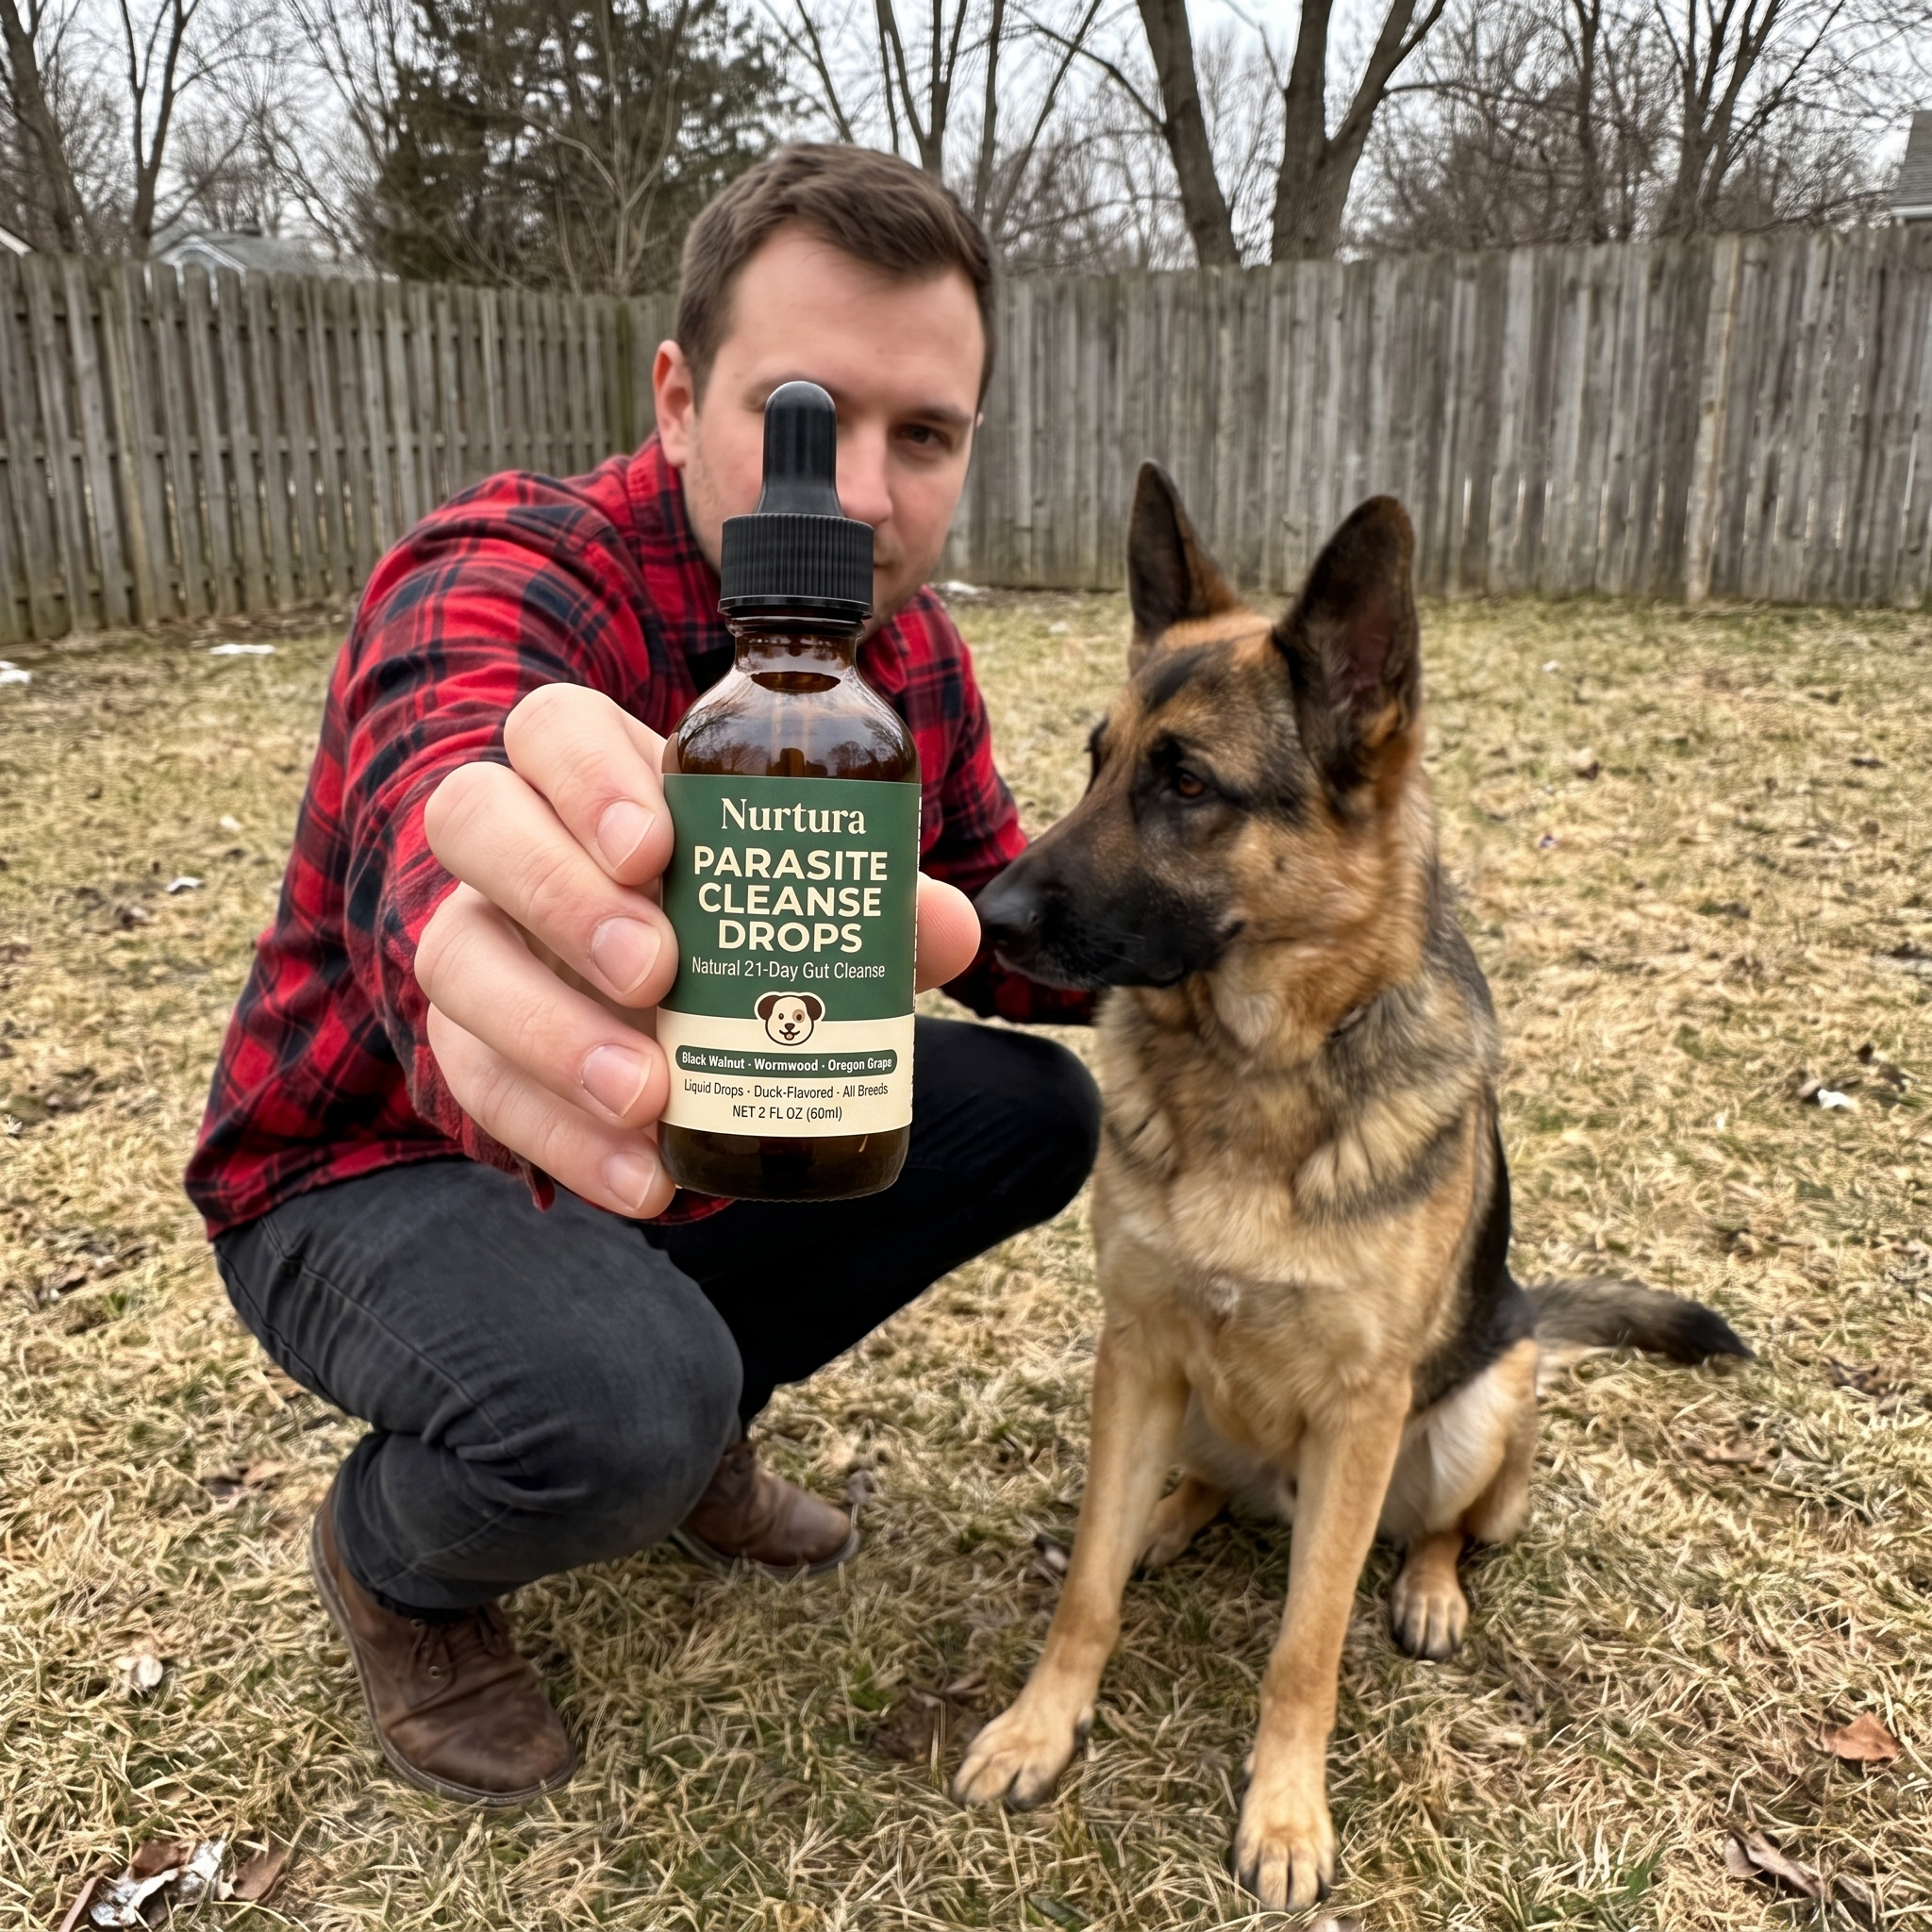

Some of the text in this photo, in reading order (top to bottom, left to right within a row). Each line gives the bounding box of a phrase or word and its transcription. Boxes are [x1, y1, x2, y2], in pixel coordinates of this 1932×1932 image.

[721, 798, 866, 835] Nurtura
[694, 845, 888, 881] PARASITE
[698, 883, 881, 917] CLEANSE
[719, 919, 862, 953] DROPS
[692, 957, 885, 981] Natural 21-Day Gut Cleanse
[682, 1052, 707, 1066] Black
[709, 1056, 745, 1070] Walnut
[755, 1058, 819, 1072] Wormwood
[828, 1058, 864, 1072] Oregon
[685, 1079, 889, 1098] Liquid Drops Duck-Flavored All Breeds
[733, 1106, 842, 1122] NET 2 FL OZ (60ml)
